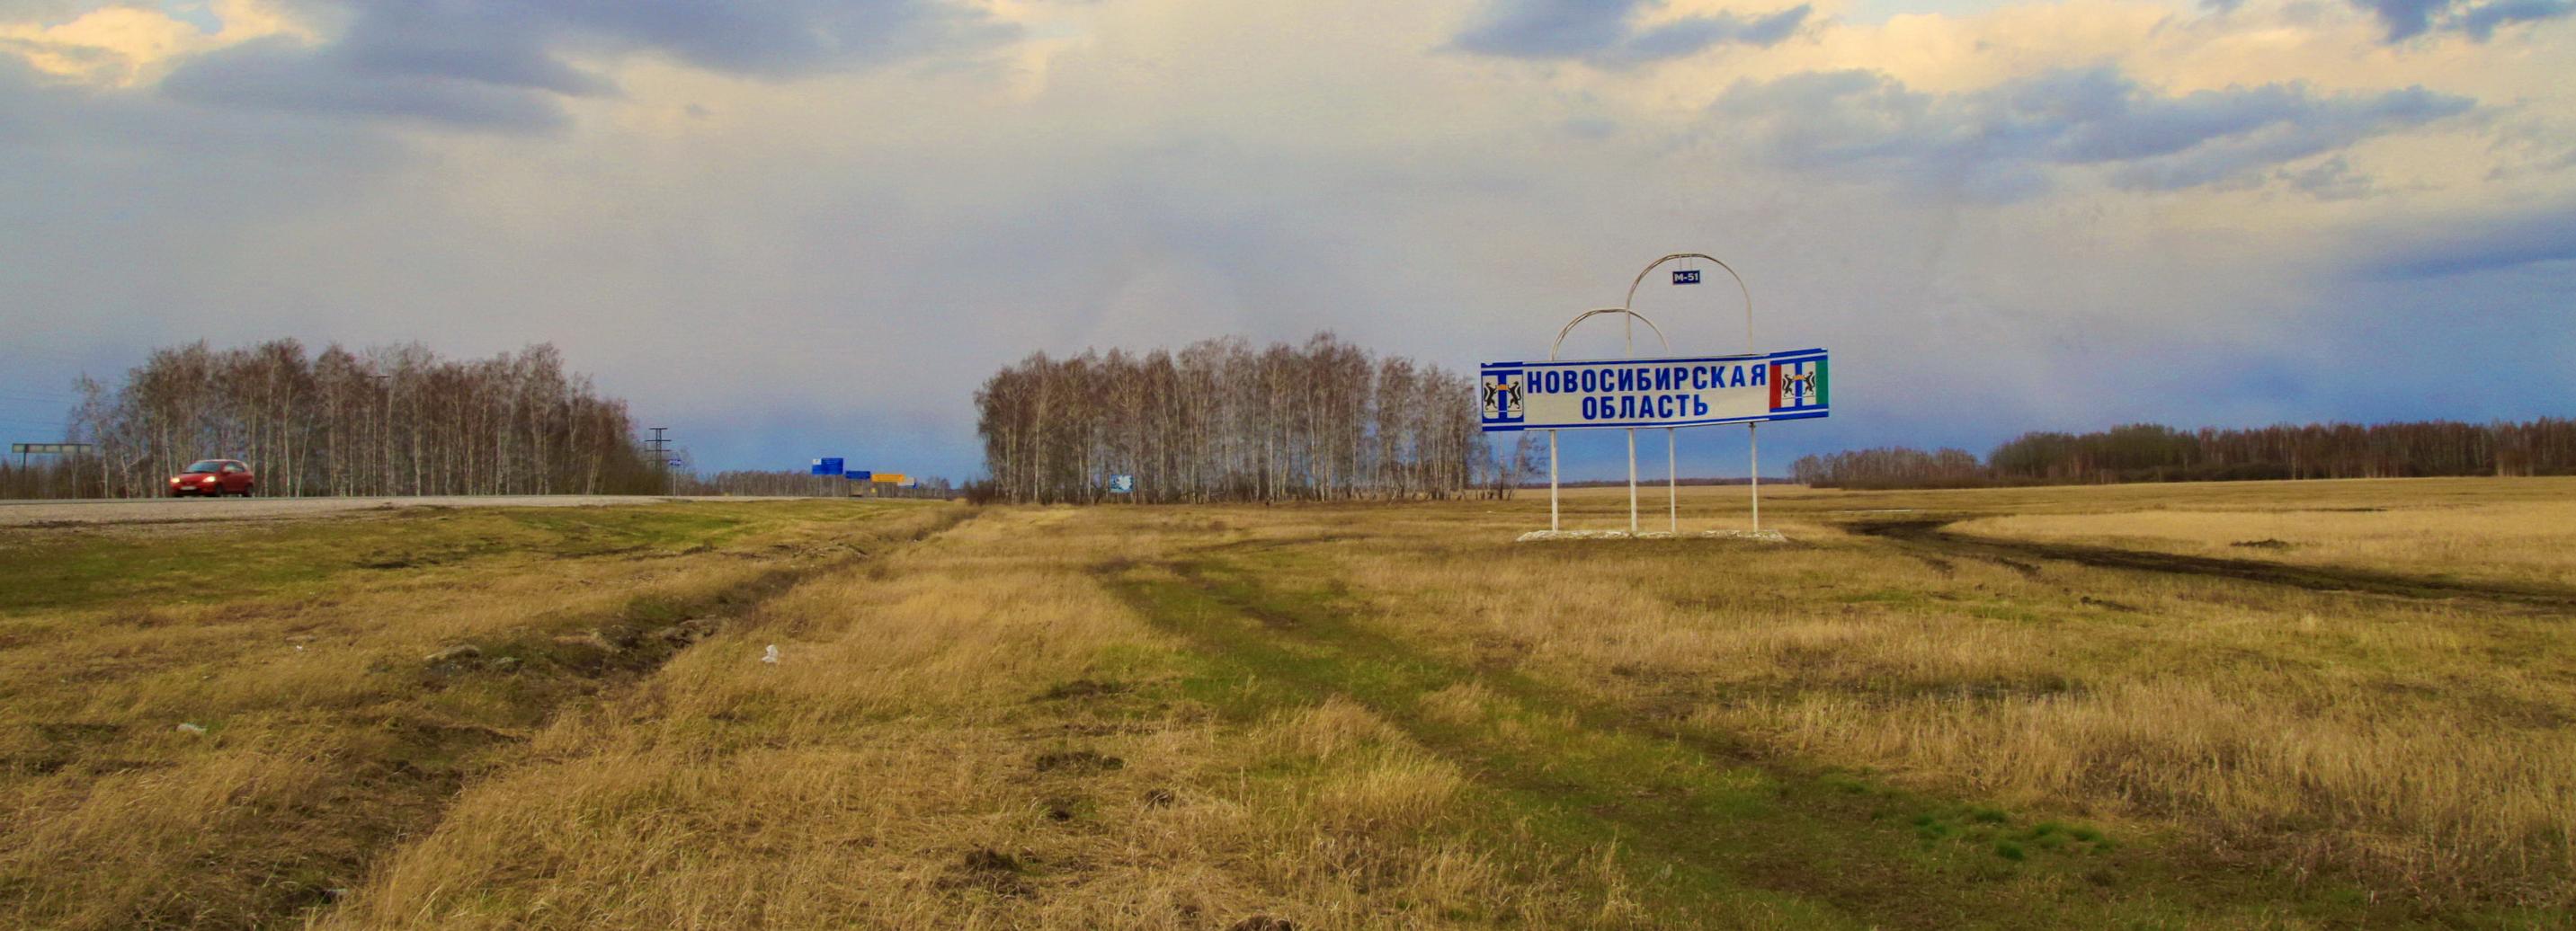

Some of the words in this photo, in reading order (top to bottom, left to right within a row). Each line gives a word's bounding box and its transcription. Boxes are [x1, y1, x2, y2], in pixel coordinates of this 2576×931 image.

[1674, 272, 1698, 281] М-51
[1527, 364, 1767, 394] НОВОСИБИРСКАЯ
[1582, 395, 1708, 420] ОБЛАСТЬ
